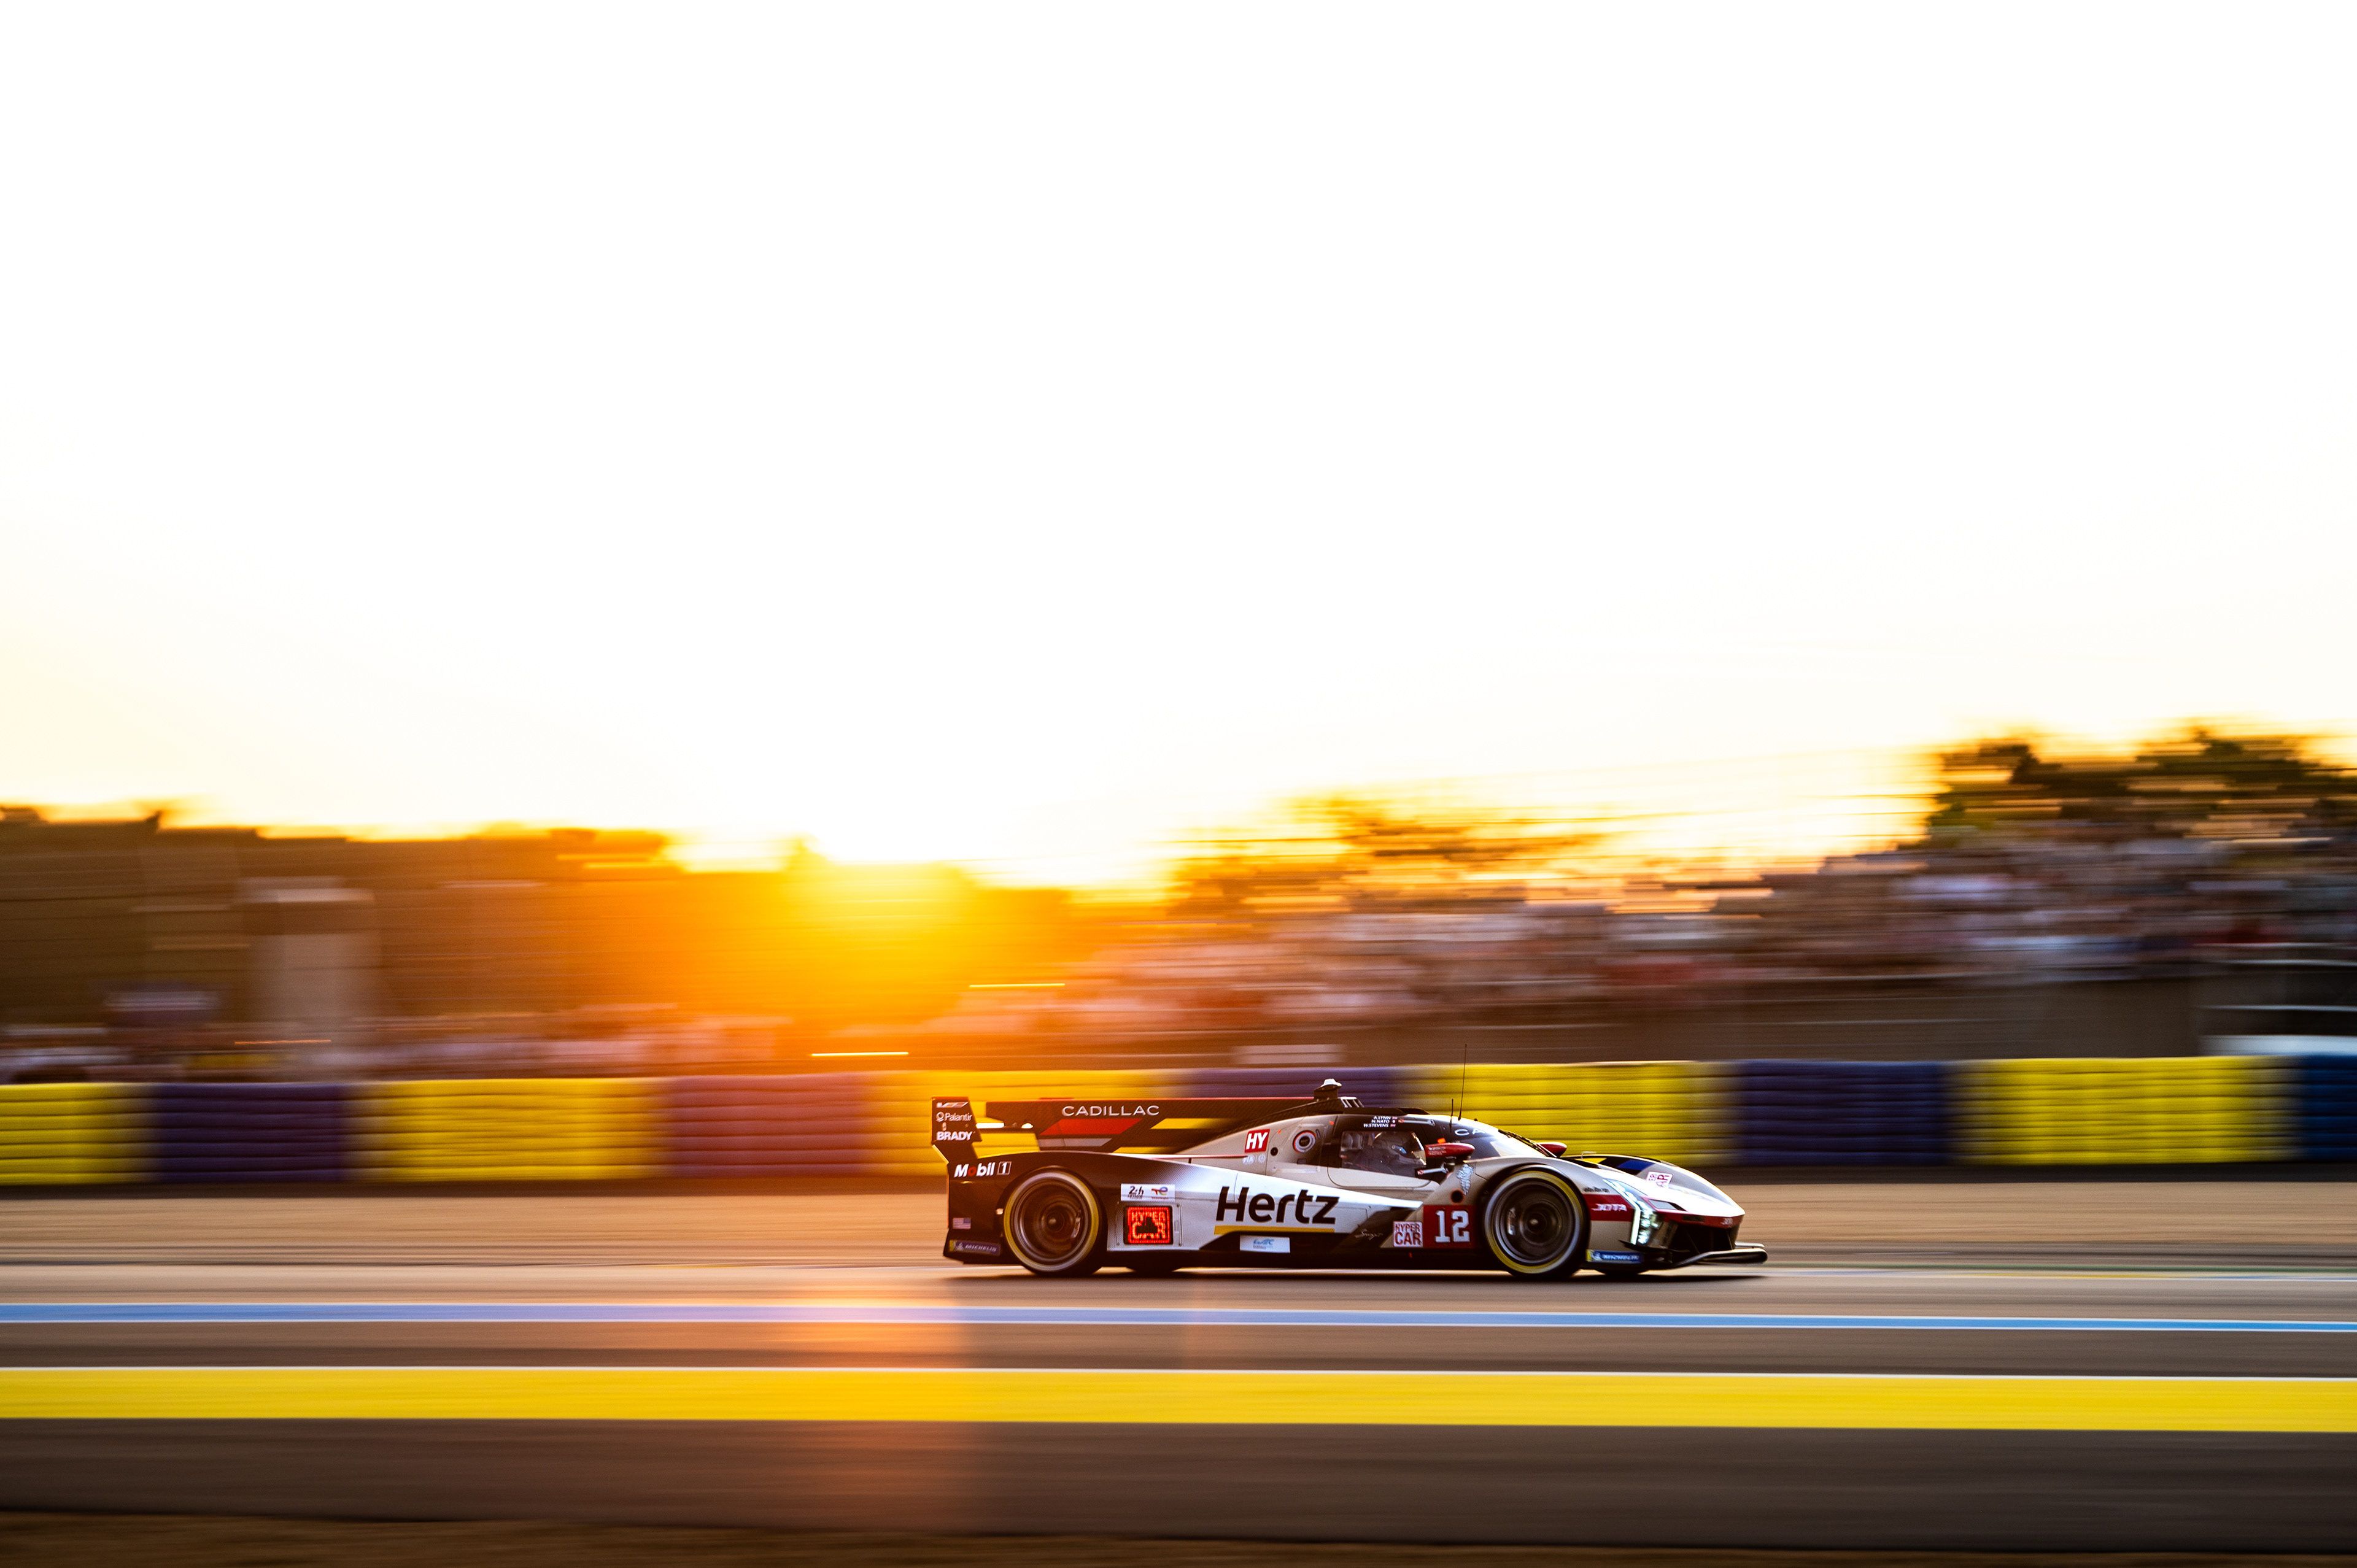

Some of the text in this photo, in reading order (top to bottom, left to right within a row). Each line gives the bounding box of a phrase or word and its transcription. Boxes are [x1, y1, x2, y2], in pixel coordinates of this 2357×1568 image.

[1061, 1105, 1159, 1116] CADILLAC
[945, 1112, 973, 1122] Palantir
[936, 1131, 973, 1141] BRADY
[1245, 1132, 1269, 1150] HY
[954, 1162, 996, 1178] Mobil
[1216, 1186, 1340, 1225] Hertz
[1395, 1223, 1421, 1233] HYPER
[1434, 1210, 1471, 1243] 12
[1395, 1232, 1423, 1245] CAR
[964, 1243, 997, 1253] MICHELIN
